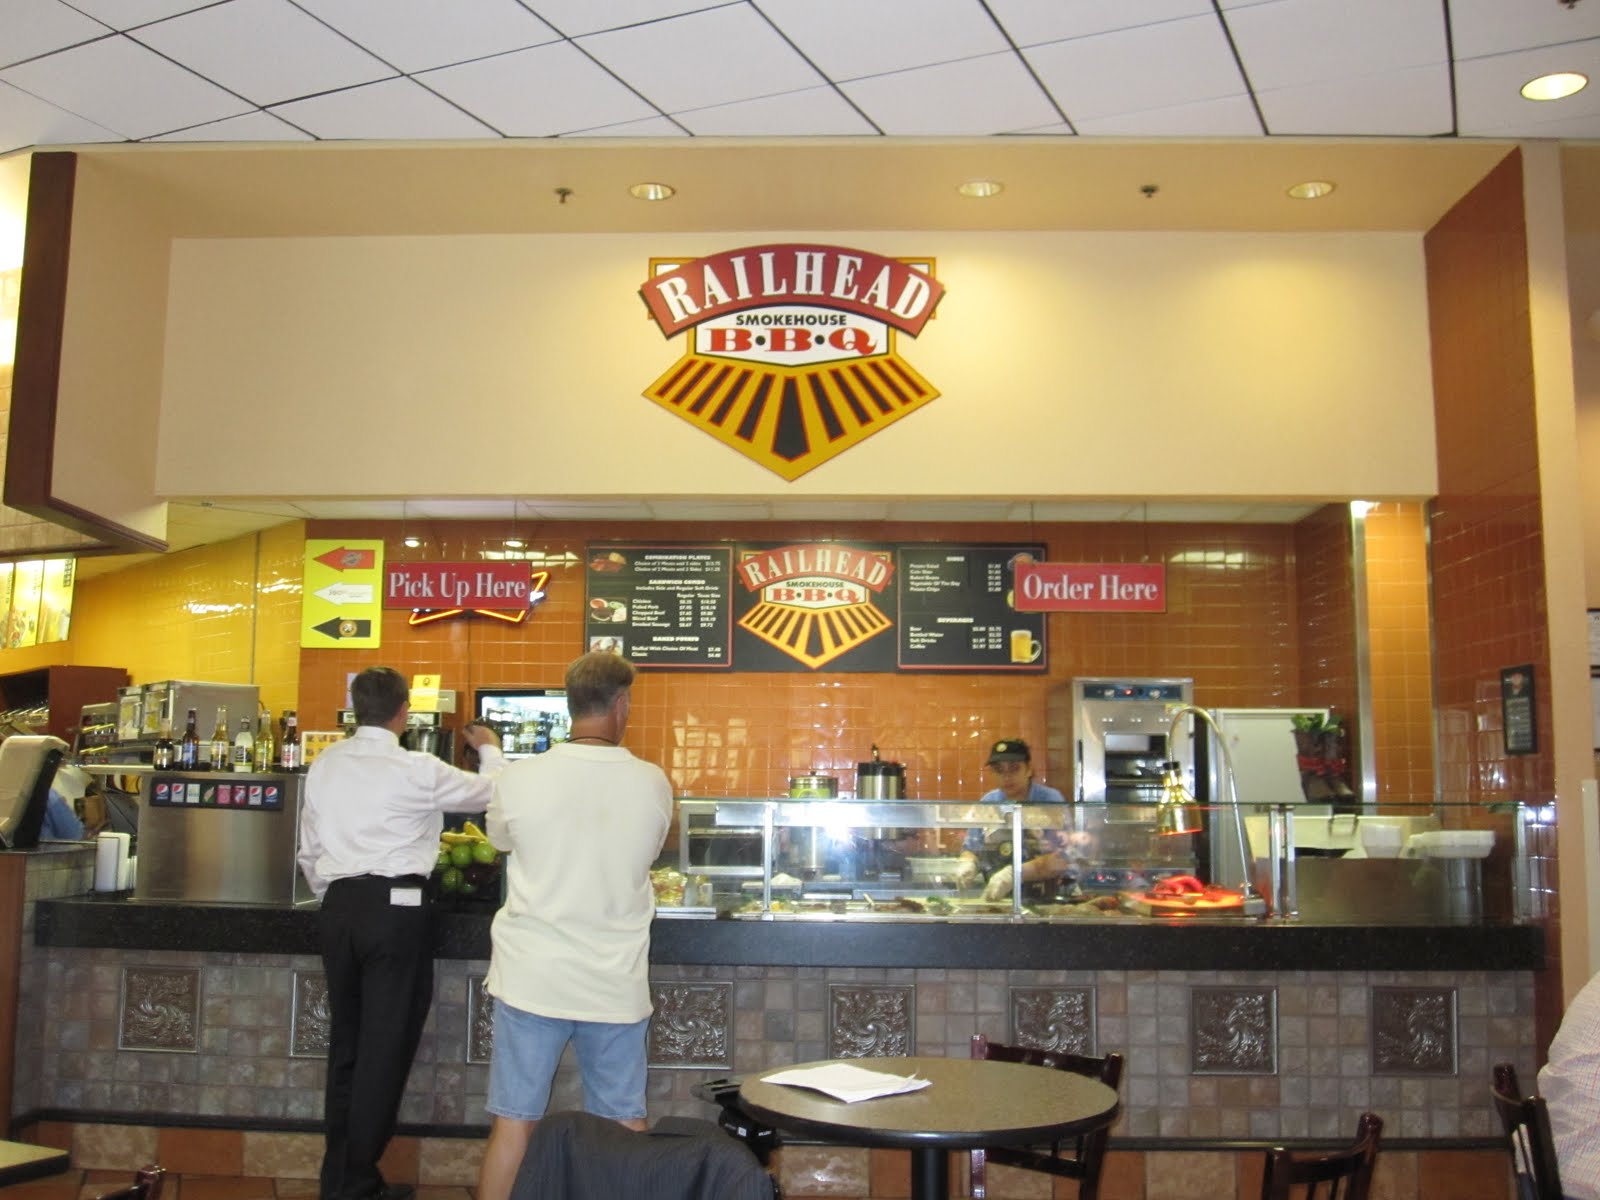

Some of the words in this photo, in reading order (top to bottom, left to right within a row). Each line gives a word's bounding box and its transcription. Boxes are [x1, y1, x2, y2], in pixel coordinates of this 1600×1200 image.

[656, 252, 932, 323] RAILHEAD
[736, 314, 847, 326] SMOKEHOUSE
[744, 549, 887, 586] RAILHEAD
[389, 571, 435, 598] Pick
[440, 572, 470, 605] Up
[474, 573, 526, 598] Here
[1023, 574, 1094, 600] Order
[1100, 575, 1157, 600] Here
